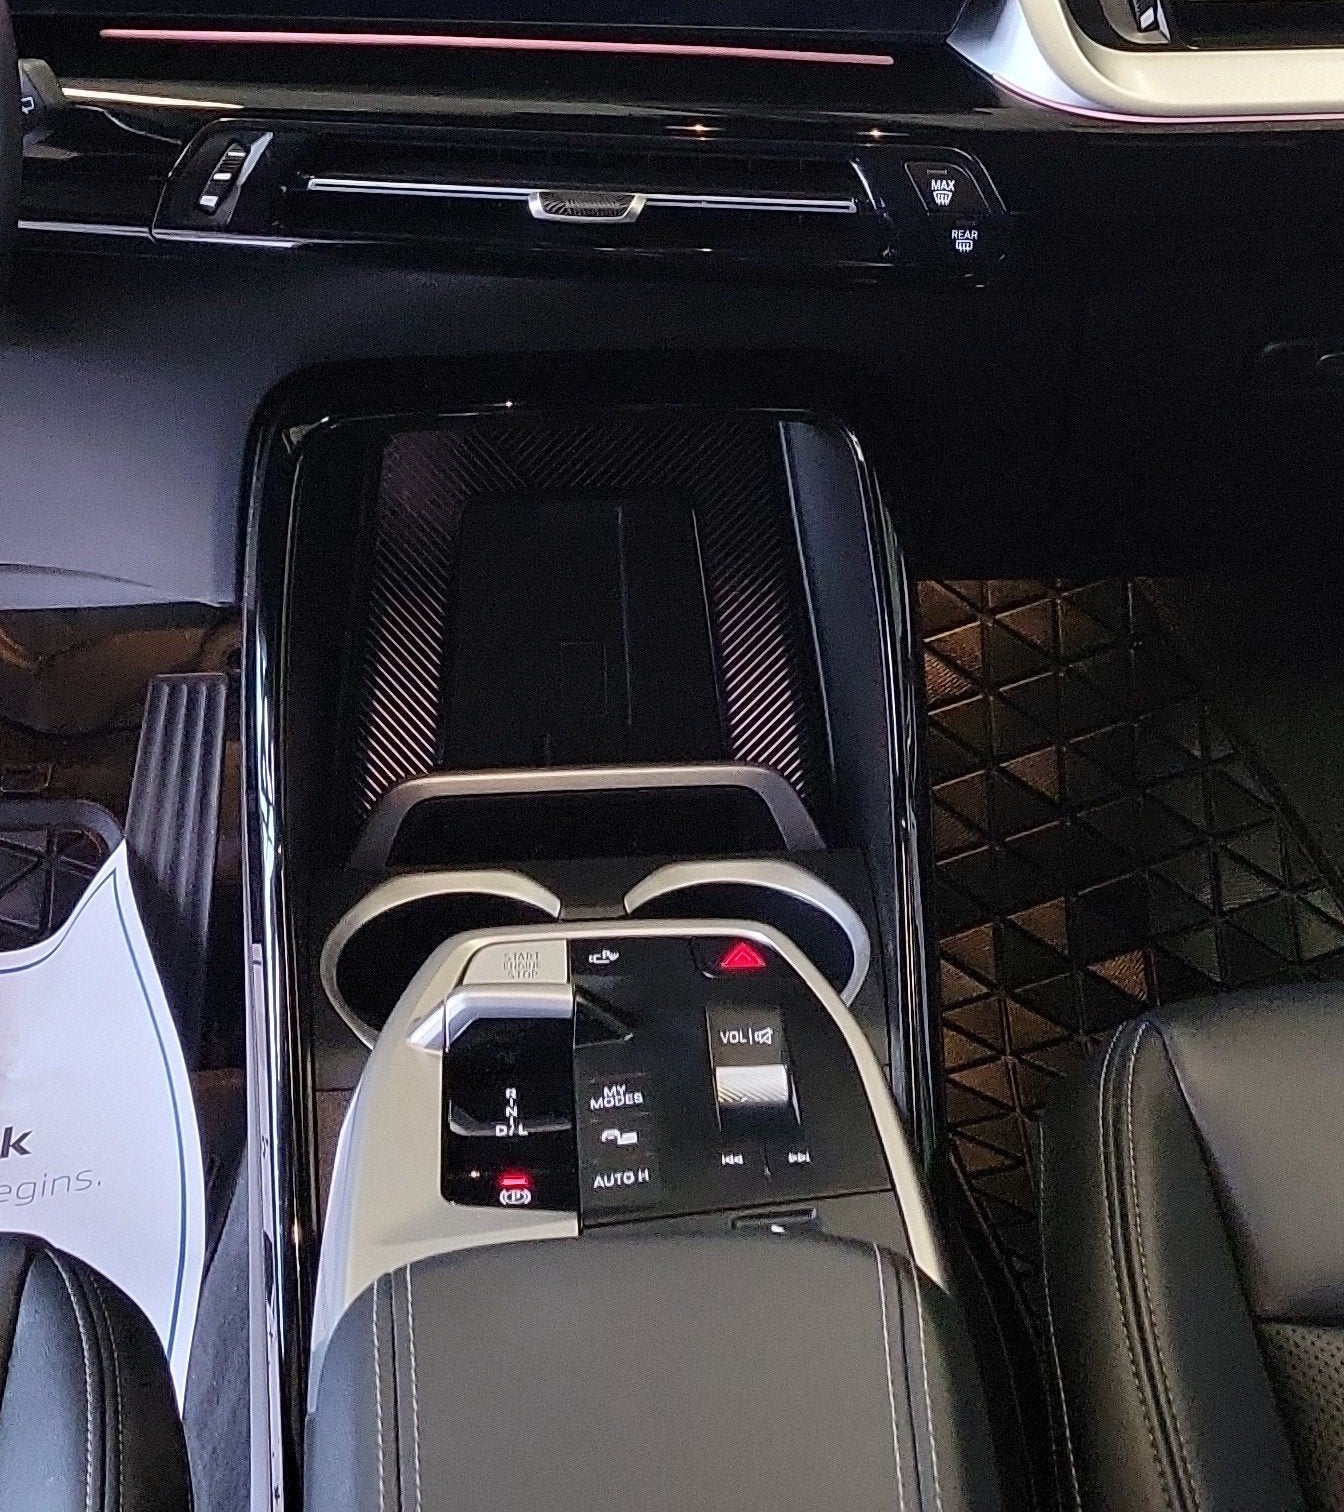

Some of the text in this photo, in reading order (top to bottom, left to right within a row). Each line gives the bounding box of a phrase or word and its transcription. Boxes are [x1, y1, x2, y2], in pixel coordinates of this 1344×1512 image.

[931, 178, 956, 192] MAX
[951, 229, 979, 241] REAR
[507, 969, 538, 980] STOP
[719, 1029, 748, 1045] VOL
[603, 1084, 627, 1098] MY
[590, 1092, 644, 1111] MODES
[506, 1105, 518, 1118] N
[593, 1168, 650, 1189] AUTO H
